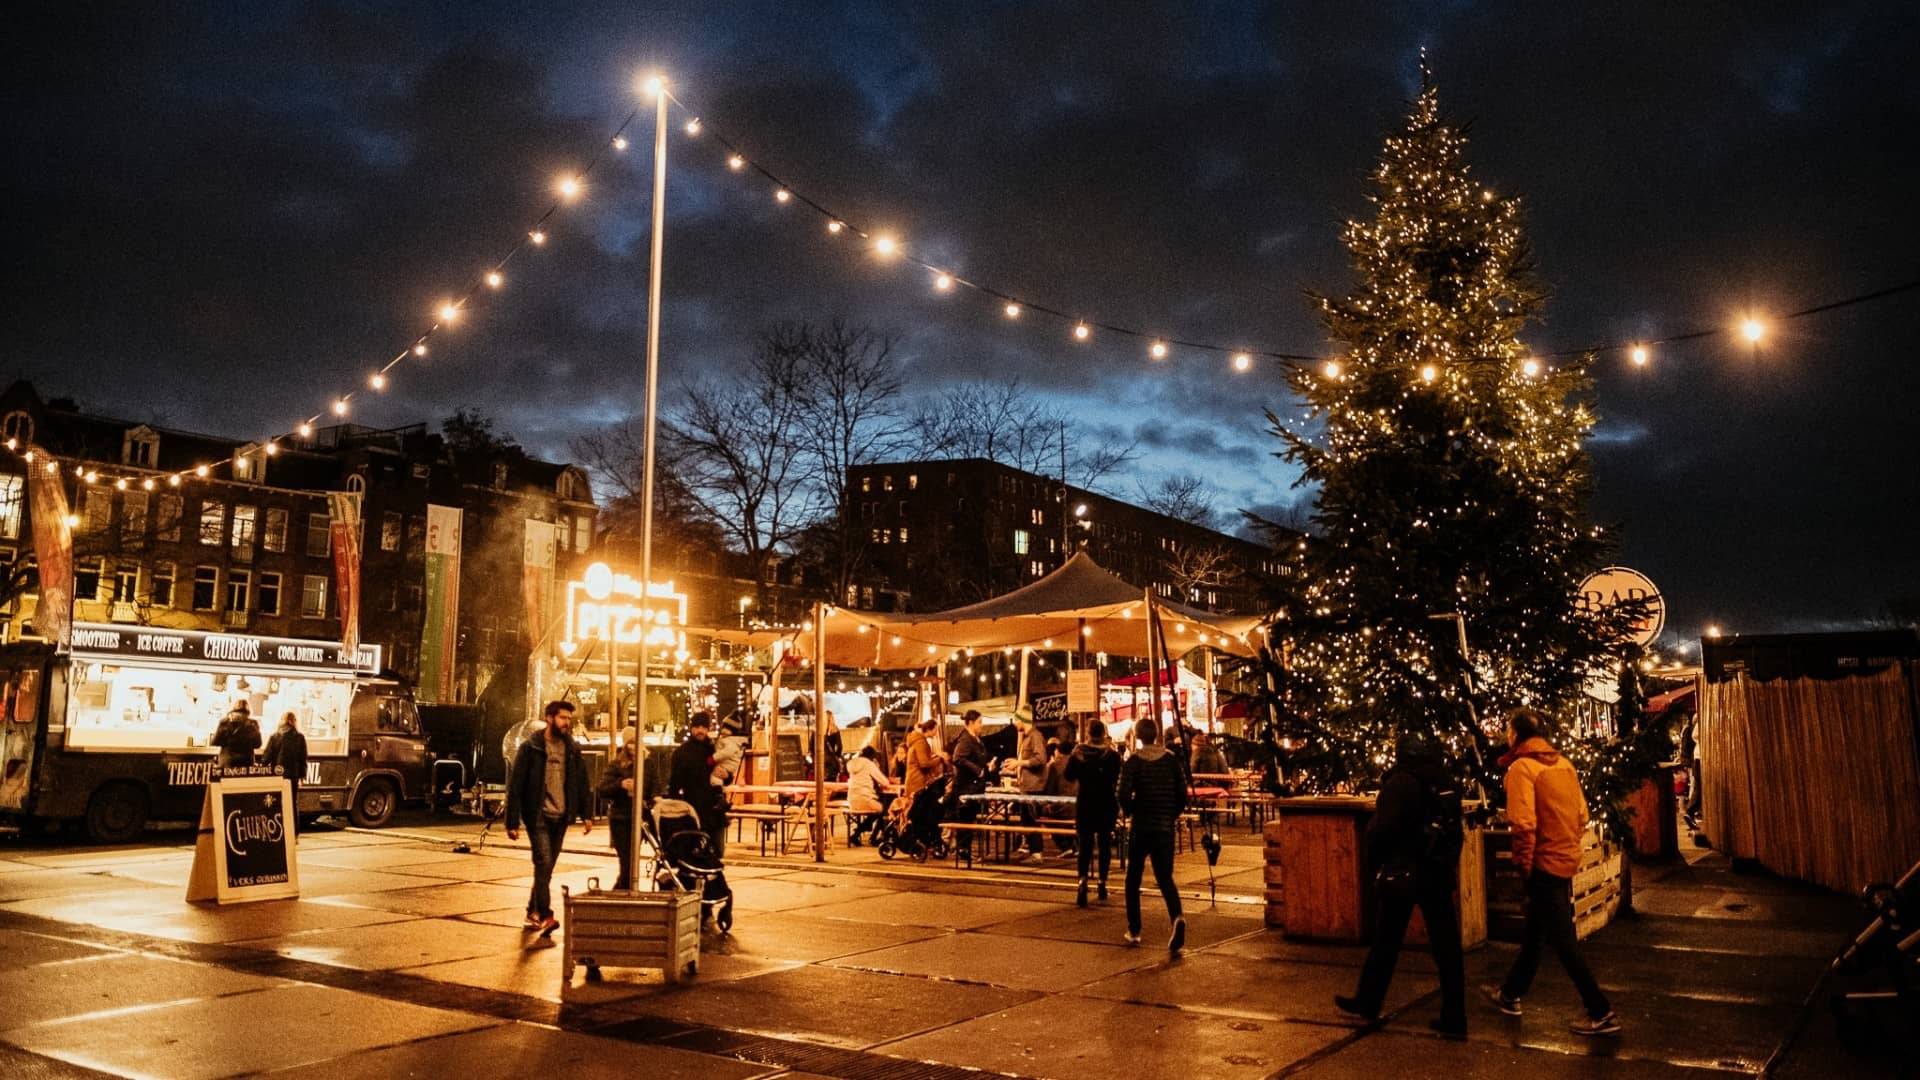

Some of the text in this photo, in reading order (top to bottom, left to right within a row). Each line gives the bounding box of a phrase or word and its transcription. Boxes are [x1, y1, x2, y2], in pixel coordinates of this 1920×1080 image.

[1584, 588, 1649, 614] BAR
[71, 629, 120, 649] SMOOTHIES
[137, 634, 184, 653] ICE COFFEE
[203, 635, 260, 661] CHURROS
[278, 645, 324, 663] COOL DRINKS
[226, 809, 283, 856] CHURROS
